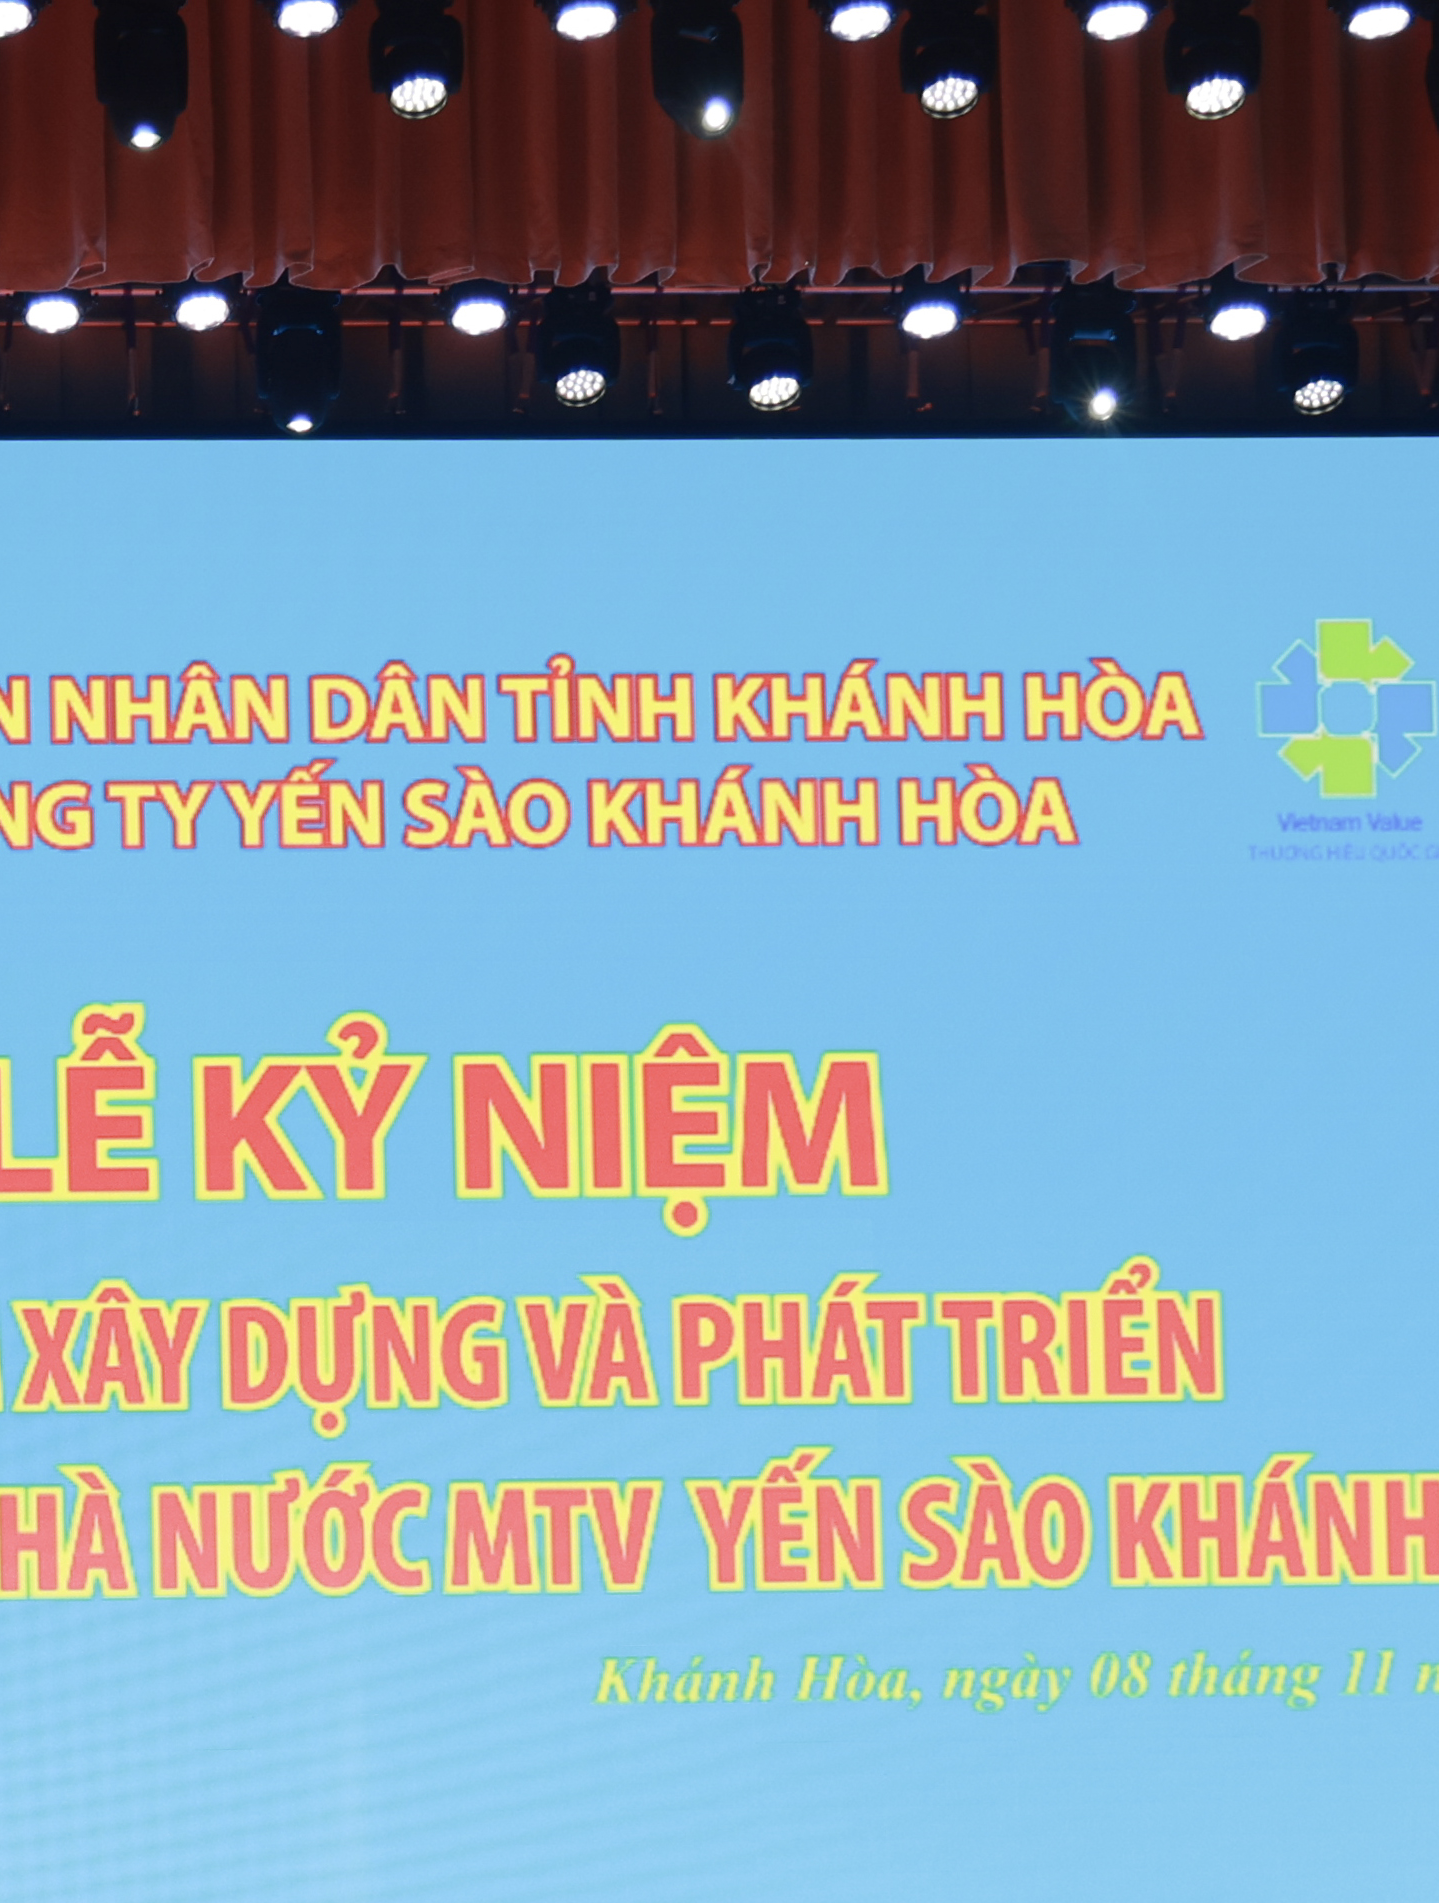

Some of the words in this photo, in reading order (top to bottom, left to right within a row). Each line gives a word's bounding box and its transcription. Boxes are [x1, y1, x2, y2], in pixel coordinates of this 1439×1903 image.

[50, 660, 288, 743] NHÂN
[310, 660, 486, 742] DÂN
[498, 652, 696, 742] TỈNH
[714, 658, 1003, 742] KHÁNH
[1023, 657, 1204, 741] HÒA
[105, 780, 214, 850] TY
[224, 758, 385, 848] YẾN
[402, 765, 571, 848] SÀO
[588, 764, 879, 847] KHÁNH
[899, 763, 1079, 846] HÒA
[1277, 811, 1363, 832] Vietnam
[1366, 811, 1423, 832] Value
[192, 1010, 429, 1200] KỶ
[452, 1023, 889, 1236] NIỆM
[13, 1278, 207, 1411] XÂY
[219, 1283, 509, 1439] DỰNG
[518, 1273, 659, 1407] VÀ
[673, 1272, 923, 1406] PHÁT
[939, 1254, 1225, 1405] TRIỂN
[151, 1460, 434, 1599] NƯỚC
[442, 1479, 661, 1594] MTV
[686, 1446, 884, 1593] YẾN
[899, 1454, 1092, 1589] SÀO
[592, 1655, 777, 1706] Khánh
[795, 1653, 926, 1712] Hòa,
[940, 1655, 1072, 1713] ngày
[1088, 1650, 1153, 1701] 08
[1167, 1650, 1325, 1709] tháng
[1340, 1650, 1394, 1698] 11
